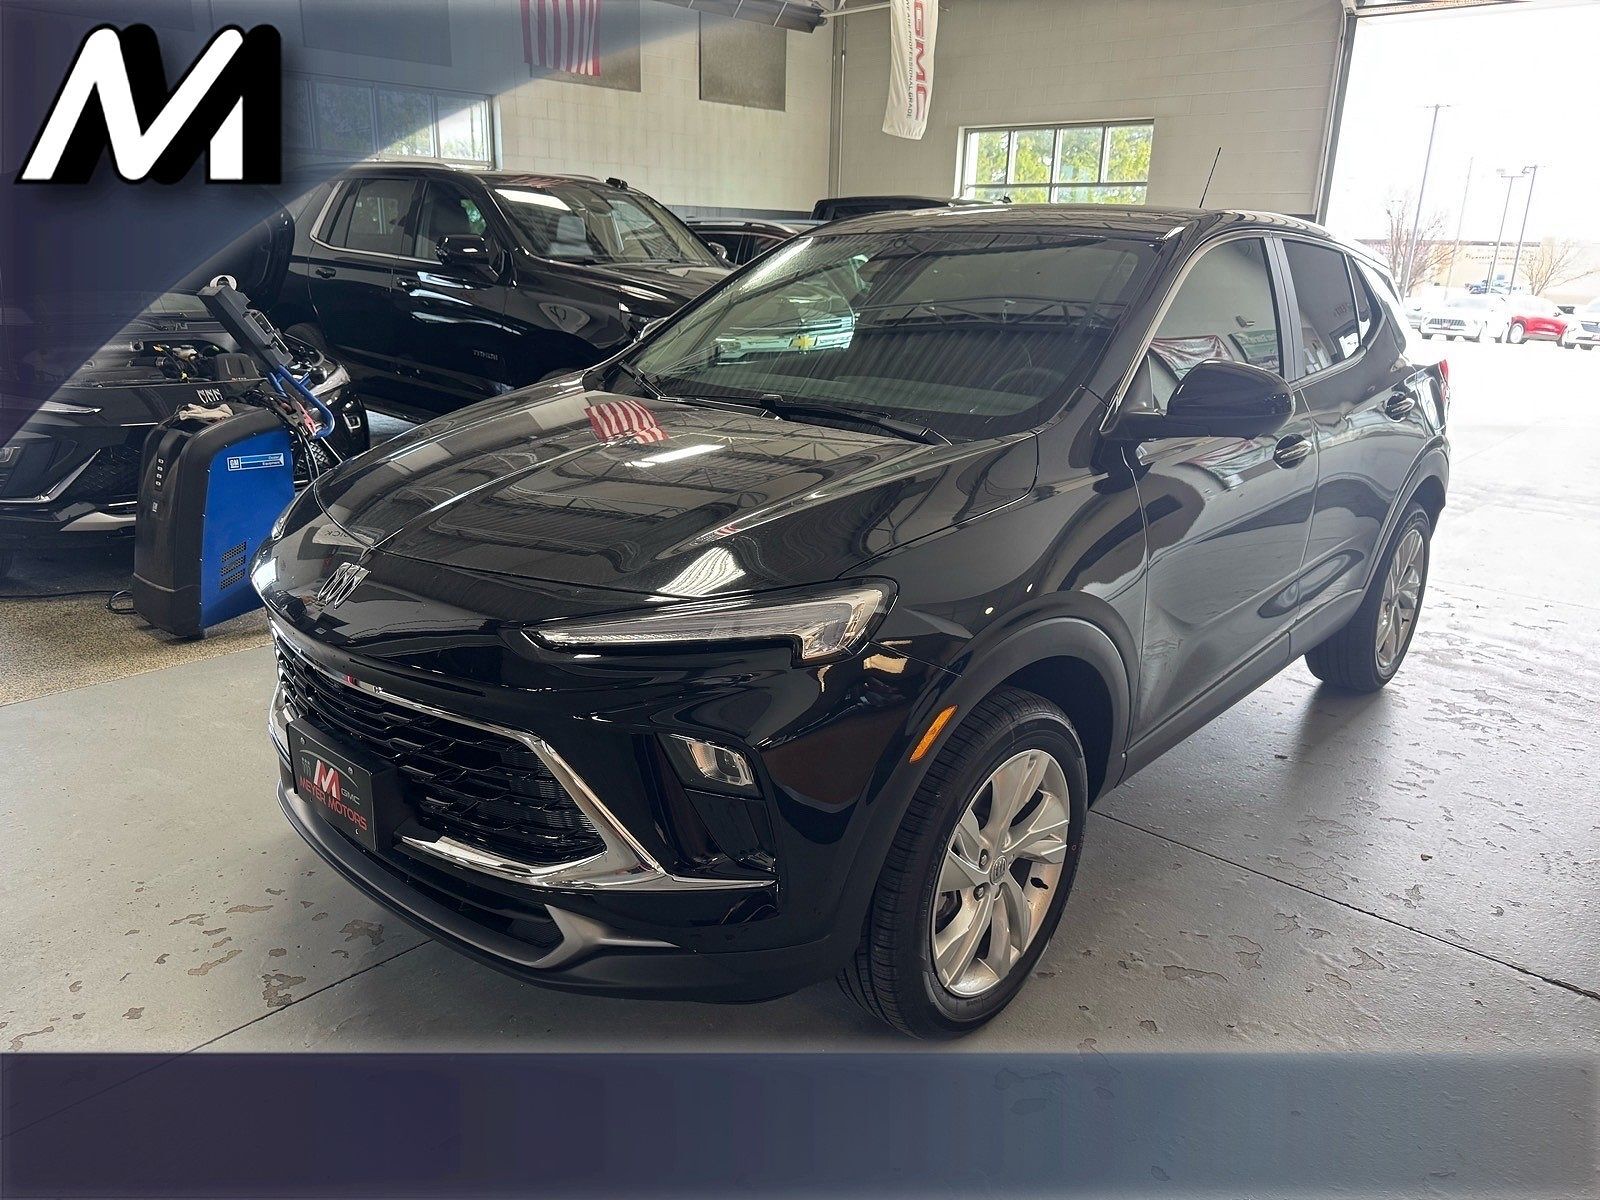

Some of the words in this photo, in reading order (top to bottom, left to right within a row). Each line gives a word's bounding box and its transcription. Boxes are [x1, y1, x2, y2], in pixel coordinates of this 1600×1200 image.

[914, 0, 927, 121] GMC
[299, 777, 328, 806] MEYER
[327, 796, 368, 831] MOTORS
[341, 787, 361, 806] GMC
